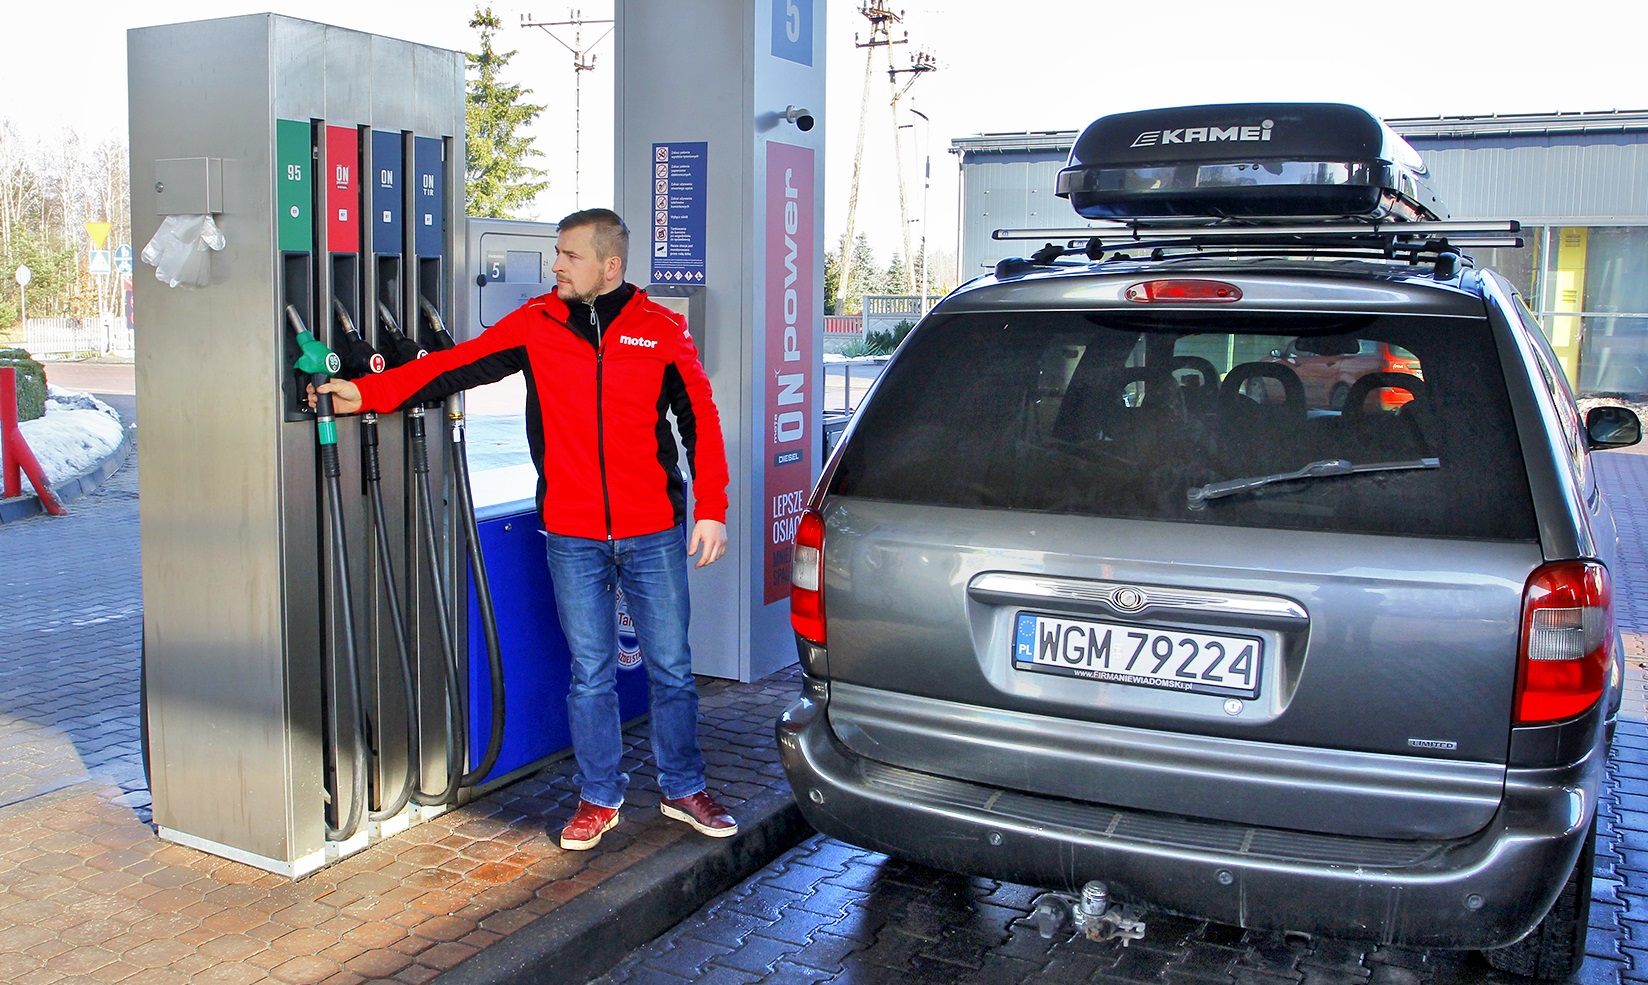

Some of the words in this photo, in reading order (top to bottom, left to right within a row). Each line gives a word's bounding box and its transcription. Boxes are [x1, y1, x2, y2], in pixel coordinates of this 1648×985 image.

[786, 0, 799, 42] 5
[287, 164, 301, 181] 95
[336, 166, 349, 182] ON
[381, 170, 393, 185] ON
[423, 174, 435, 188] ON
[423, 188, 435, 197] TIR
[491, 262, 500, 279] 5
[784, 168, 800, 362] power
[620, 335, 658, 348] motor
[778, 373, 804, 443] ON
[778, 452, 799, 463] DIESEL
[773, 490, 804, 519] LEPSZE
[1019, 644, 1032, 656] PL
[1039, 621, 1112, 669] WGM
[1124, 631, 1253, 685] 79224
